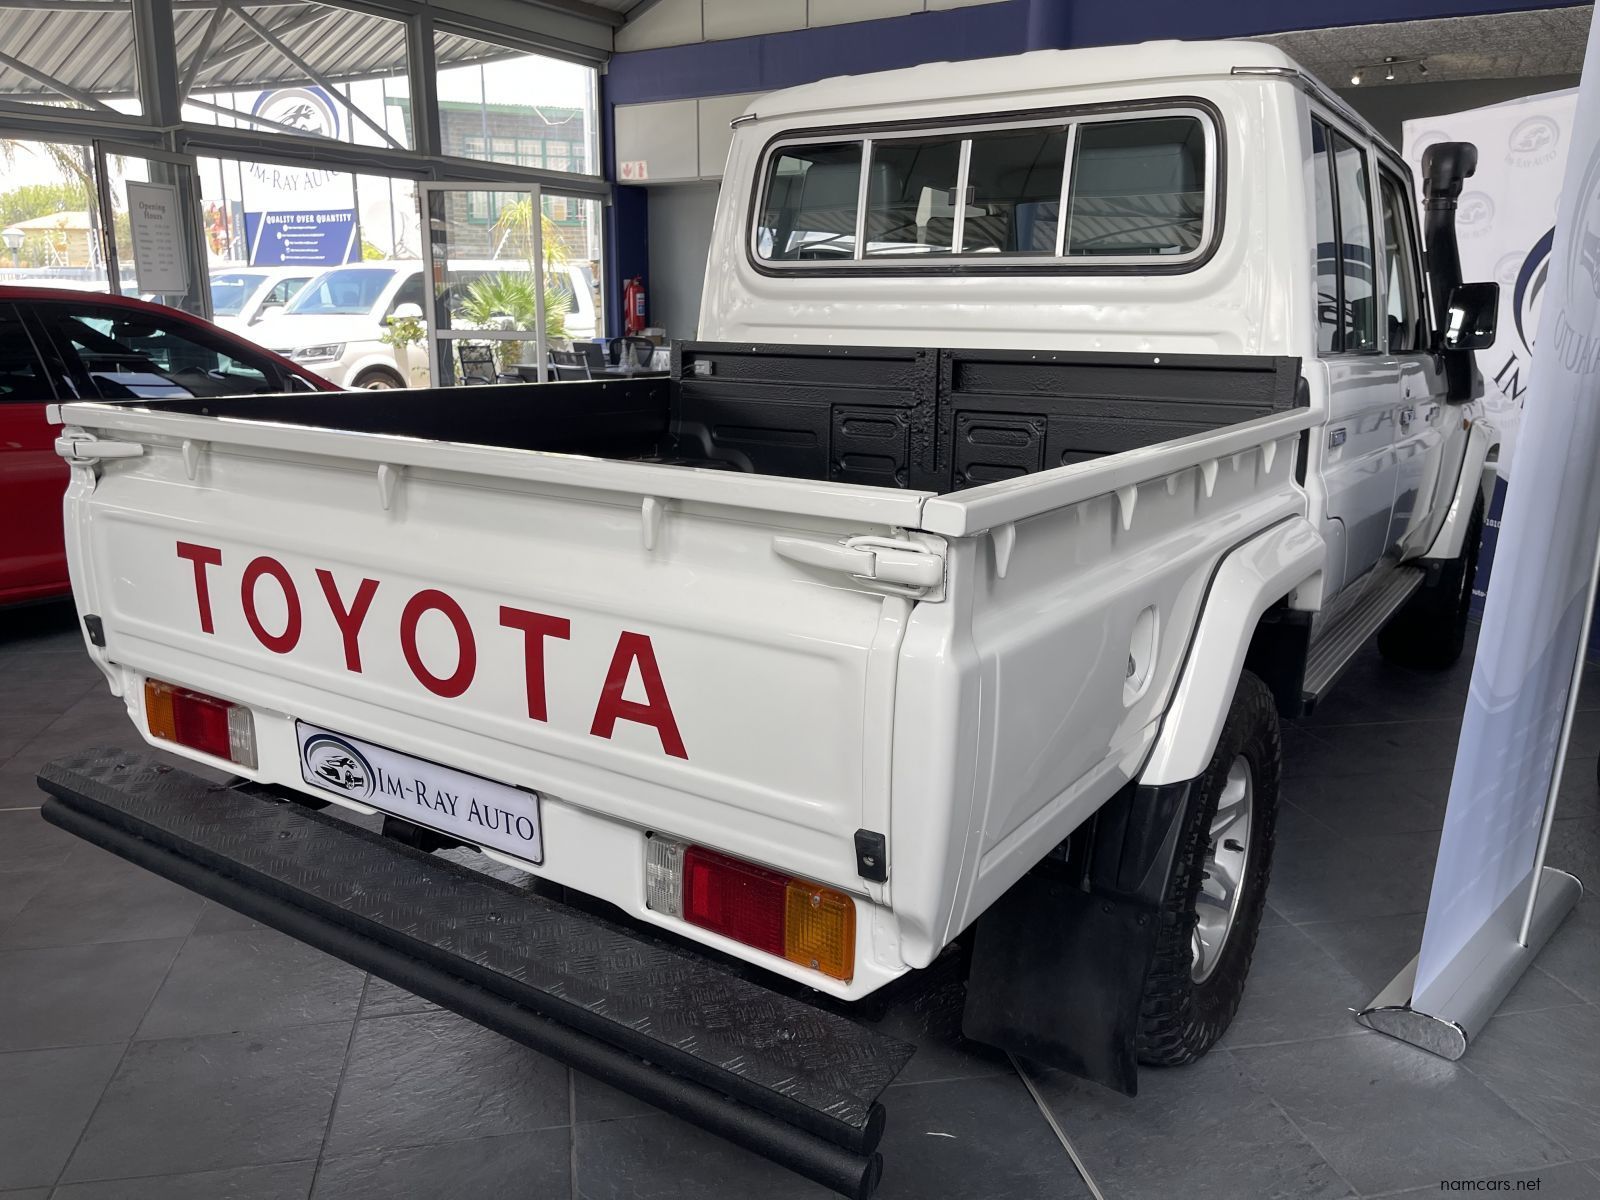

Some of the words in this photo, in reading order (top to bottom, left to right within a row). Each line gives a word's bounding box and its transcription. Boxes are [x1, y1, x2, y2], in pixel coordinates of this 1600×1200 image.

[139, 201, 165, 214] Opening
[144, 210, 162, 220] Hours
[266, 215, 294, 224] QUALITY
[296, 215, 314, 224] OVER
[316, 213, 351, 224] QUANTITY
[176, 540, 689, 760] TOYOTA
[467, 797, 534, 841] AUTO
